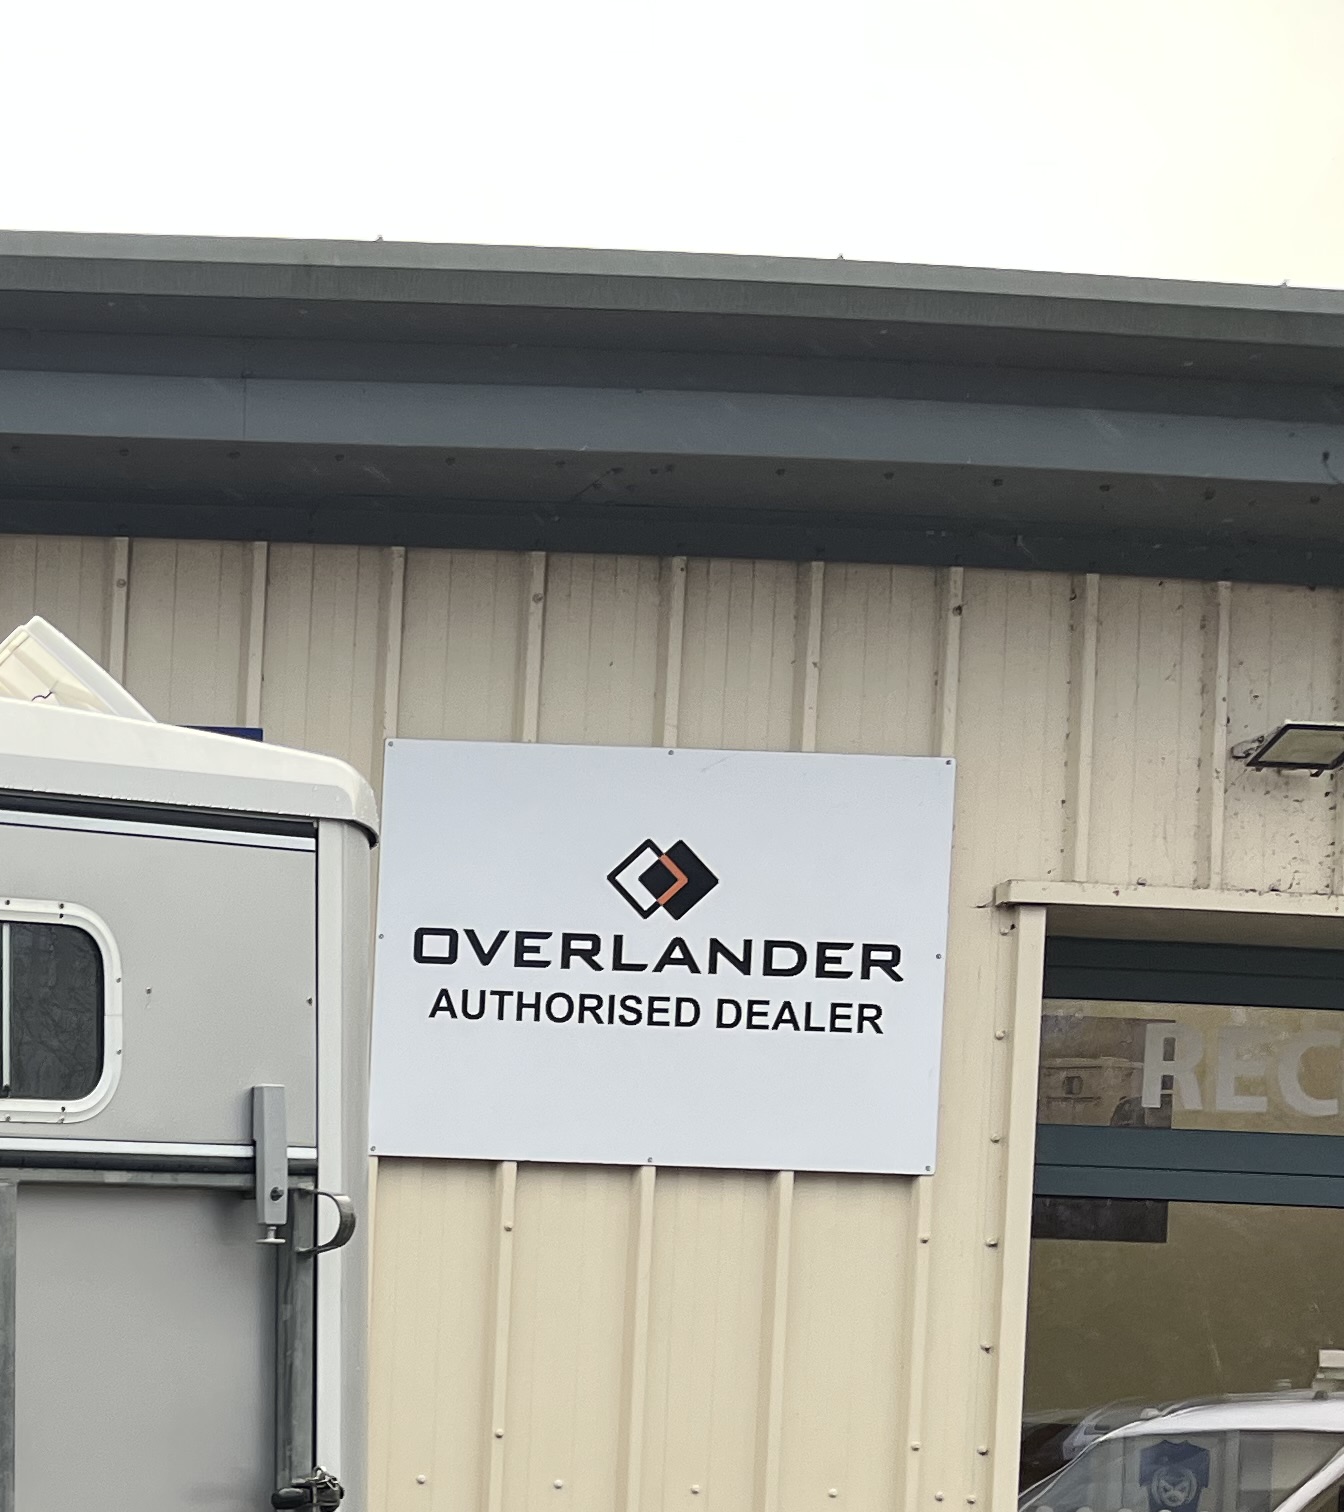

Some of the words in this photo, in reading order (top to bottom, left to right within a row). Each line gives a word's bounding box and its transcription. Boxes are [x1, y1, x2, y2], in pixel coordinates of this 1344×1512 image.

[413, 926, 904, 982] OVERLANDER
[428, 988, 701, 1028] AUTHORISED
[715, 1000, 883, 1035] DEALER
